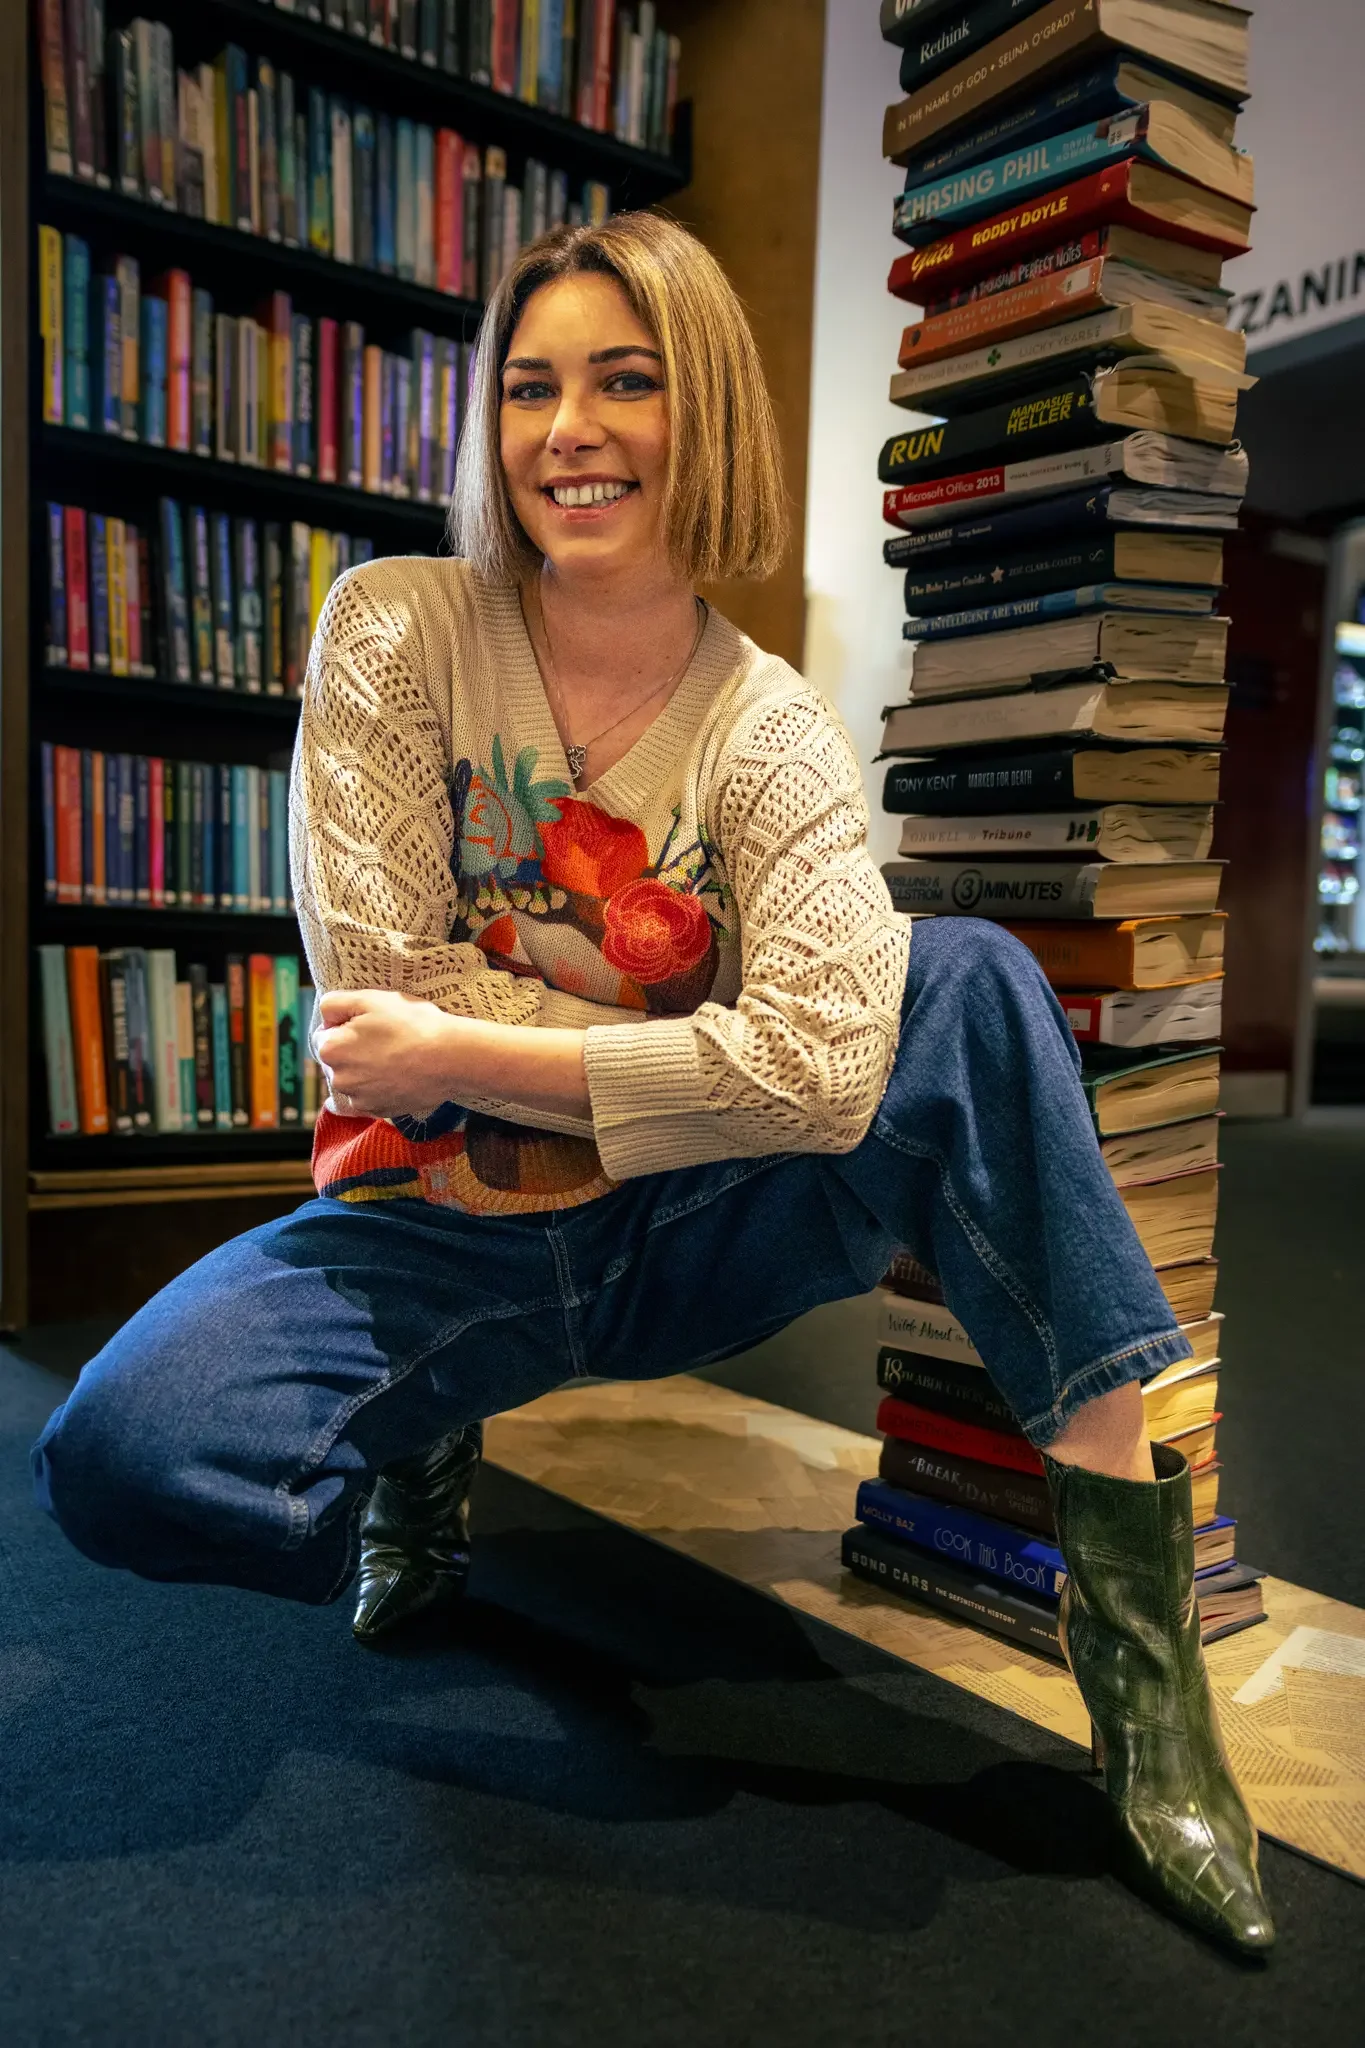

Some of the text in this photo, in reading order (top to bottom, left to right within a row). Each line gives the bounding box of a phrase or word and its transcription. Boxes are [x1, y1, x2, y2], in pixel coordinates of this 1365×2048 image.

[919, 20, 971, 64] Rethink
[898, 9, 1077, 132] IN THE NAME OF GOD SELINA O'GRADY
[1056, 142, 1098, 164] HOWARD
[1062, 134, 1093, 152] DAVID
[900, 147, 1050, 223] CHASING PHIL
[972, 216, 1019, 247] RODDY
[1020, 196, 1068, 229] DOYLE
[1018, 256, 1052, 285] PERFECT
[1055, 244, 1082, 268] NOTES
[946, 306, 978, 329] ATLAS
[1019, 339, 1053, 358] LUCKY
[1056, 328, 1092, 349] YEARS
[1006, 404, 1072, 435] HELLER
[1009, 392, 1074, 419] MANDASUE
[889, 428, 945, 466] RUN
[902, 487, 944, 505] Microsoft
[946, 482, 974, 496] Office
[976, 475, 1000, 490] 2013
[888, 534, 926, 552] CHRISTIAN
[928, 528, 953, 543] NAMES
[910, 585, 924, 597] The
[926, 581, 943, 596] Baby
[962, 573, 986, 588] Guide
[907, 601, 1039, 635] HOW INTELLIGENT ARE YOU?
[894, 769, 1033, 793] TONY KENT MARKED FOR DEATH
[910, 831, 960, 843] ORWELL
[982, 829, 1032, 842] Tribune
[984, 881, 1063, 900] MINUTES
[888, 1313, 917, 1337] Wilde
[918, 1323, 954, 1342] About
[915, 1375, 984, 1405] ABDUCTION
[888, 1413, 964, 1442] SOMETHING
[986, 1403, 1016, 1422] PATT
[916, 1457, 960, 1486] BREAK
[965, 1482, 999, 1507] DAY
[862, 1505, 893, 1523] MOLLY
[895, 1516, 915, 1532] BAZ
[933, 1527, 972, 1561] COOK
[978, 1542, 997, 1570] THIS
[1004, 1552, 1046, 1589] BOOK
[851, 1551, 888, 1575] BOND
[893, 1568, 929, 1592] CARS
[935, 1587, 947, 1598] THE
[948, 1591, 986, 1614] DEFINITIVE
[987, 1607, 1016, 1626] HISTORY
[1030, 1626, 1047, 1637] JASON
